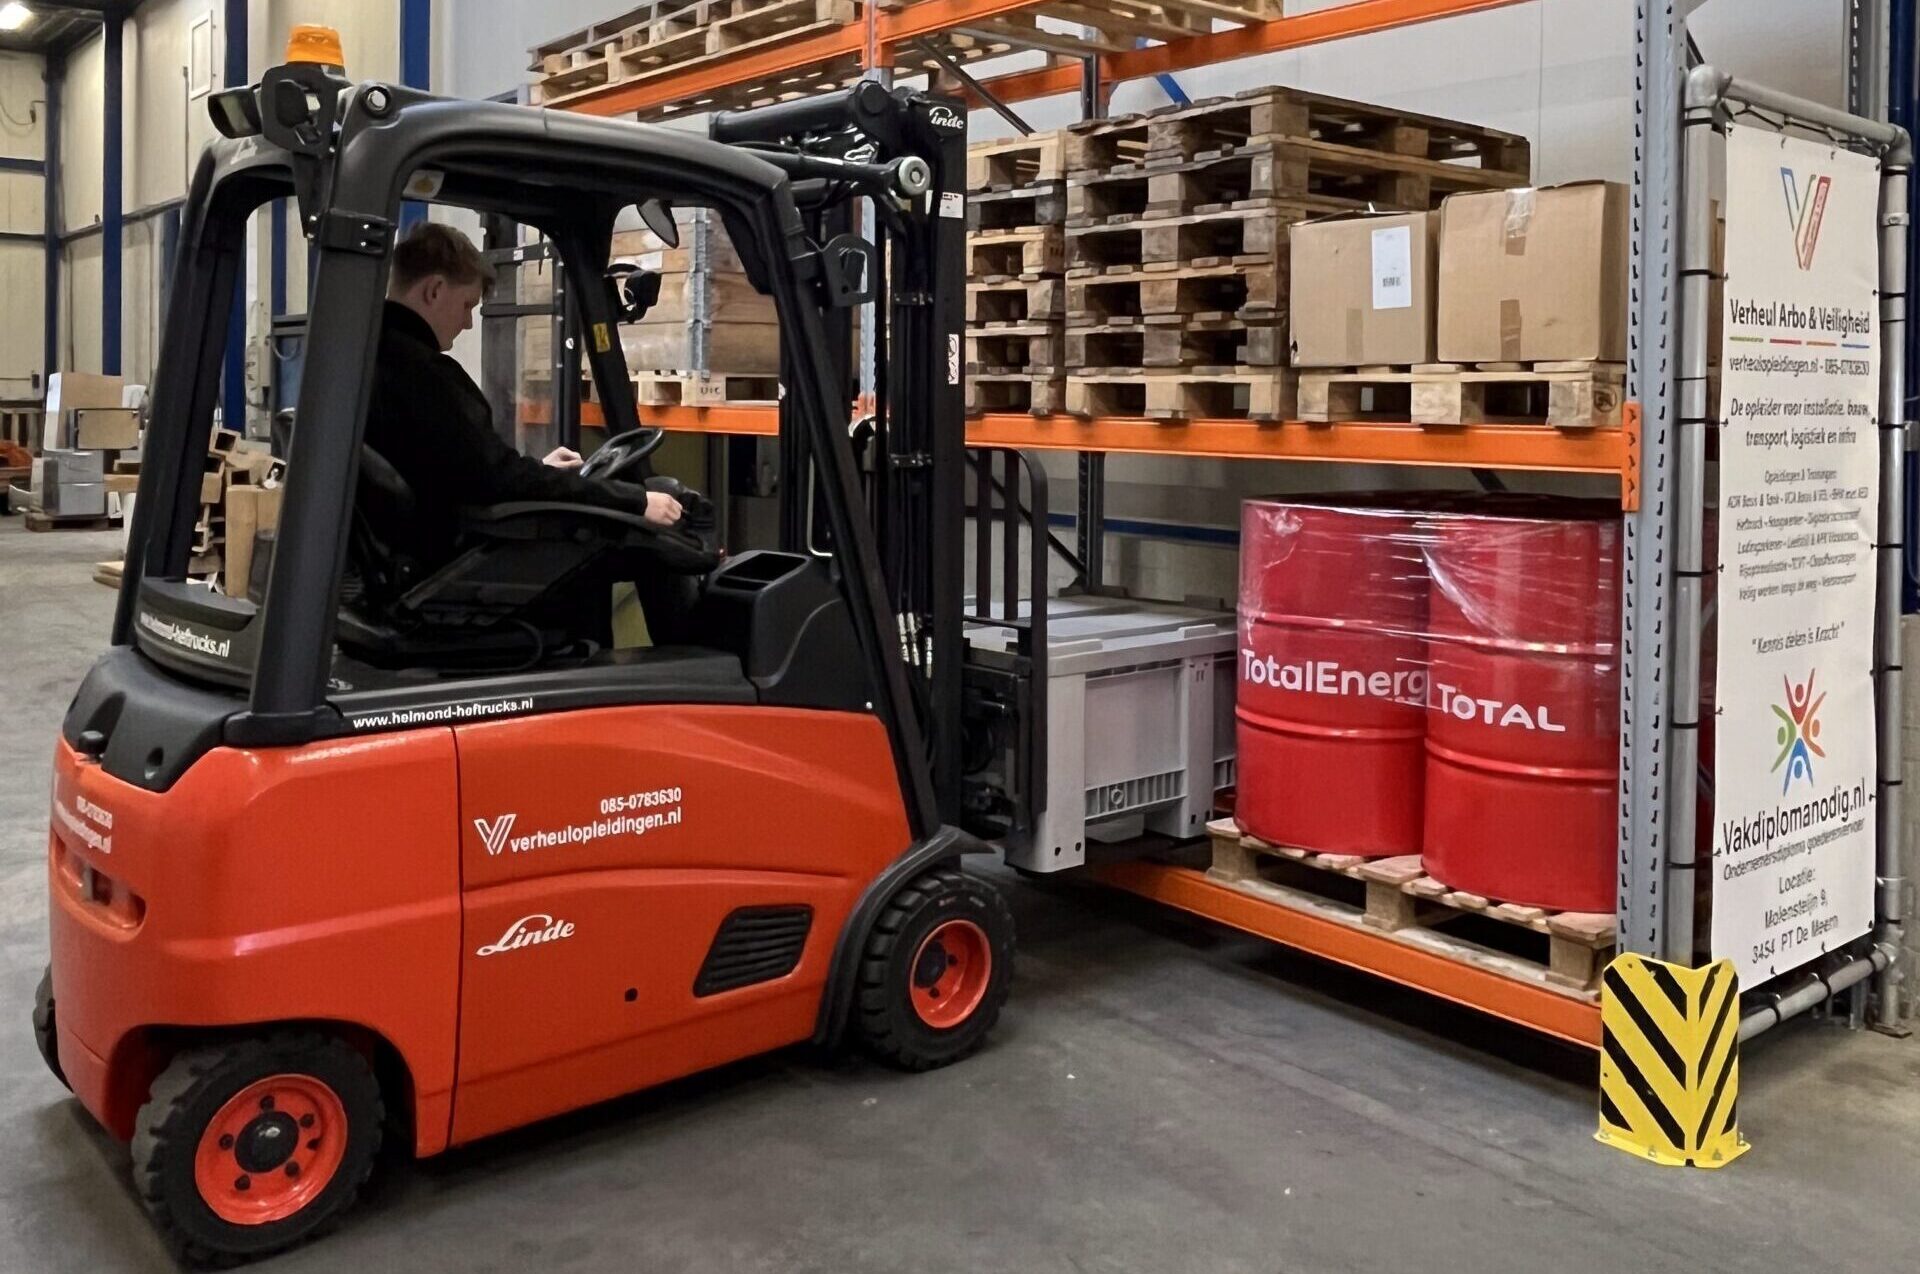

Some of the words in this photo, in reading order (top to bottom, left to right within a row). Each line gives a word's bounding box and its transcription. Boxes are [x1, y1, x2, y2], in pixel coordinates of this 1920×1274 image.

[1730, 298, 1776, 327] Verheul
[1779, 303, 1806, 329] Arbo
[1809, 306, 1817, 329] &
[1819, 307, 1870, 338] Veiligheid
[1731, 398, 1743, 416] De
[1745, 398, 1782, 420] opleider
[1746, 429, 1788, 450] transport,
[1791, 427, 1825, 450] logistiek
[1827, 431, 1837, 444] en
[353, 698, 533, 729] www.helmond-heftrucks.nl
[1437, 683, 1566, 732] TOTAL
[600, 787, 682, 815] 085-0783630
[1723, 777, 1866, 855] Vakdiplomanodig.nl
[510, 807, 682, 853] verheulopleidingen.nl
[1779, 867, 1816, 894] Locatie:
[476, 914, 575, 956] Linde
[1752, 939, 1775, 964] 3454
[1781, 930, 1793, 951] PT
[1797, 927, 1808, 944] De
